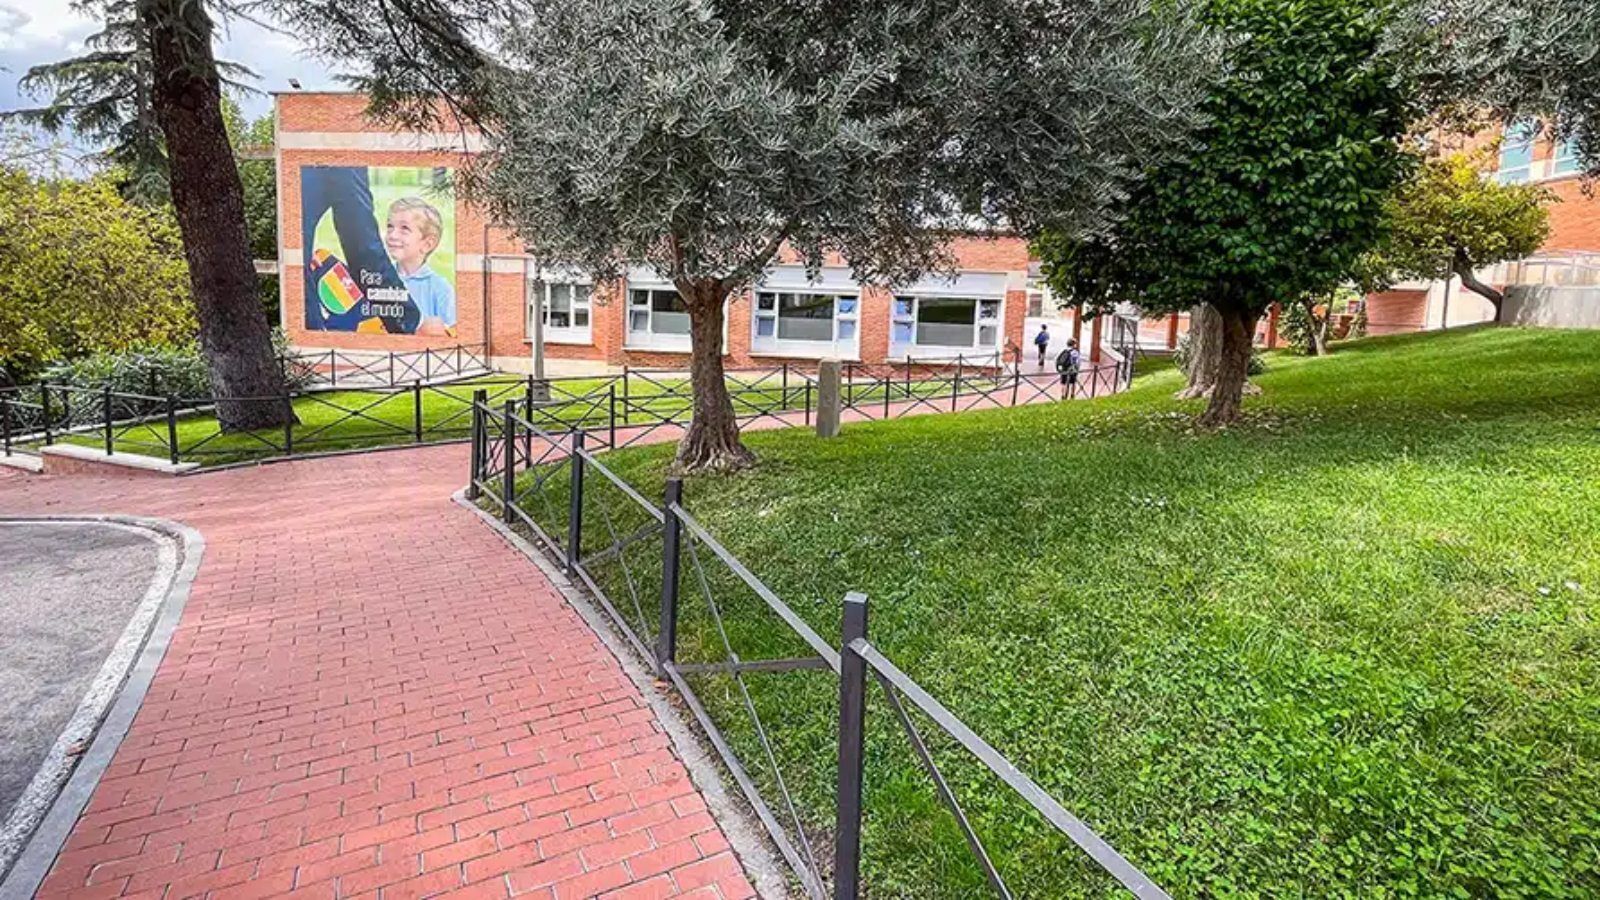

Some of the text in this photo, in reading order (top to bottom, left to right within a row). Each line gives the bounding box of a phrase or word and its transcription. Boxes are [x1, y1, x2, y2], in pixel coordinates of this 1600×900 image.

[360, 269, 382, 285] Para
[367, 286, 408, 301] cambiar
[361, 301, 404, 317] el mundo
